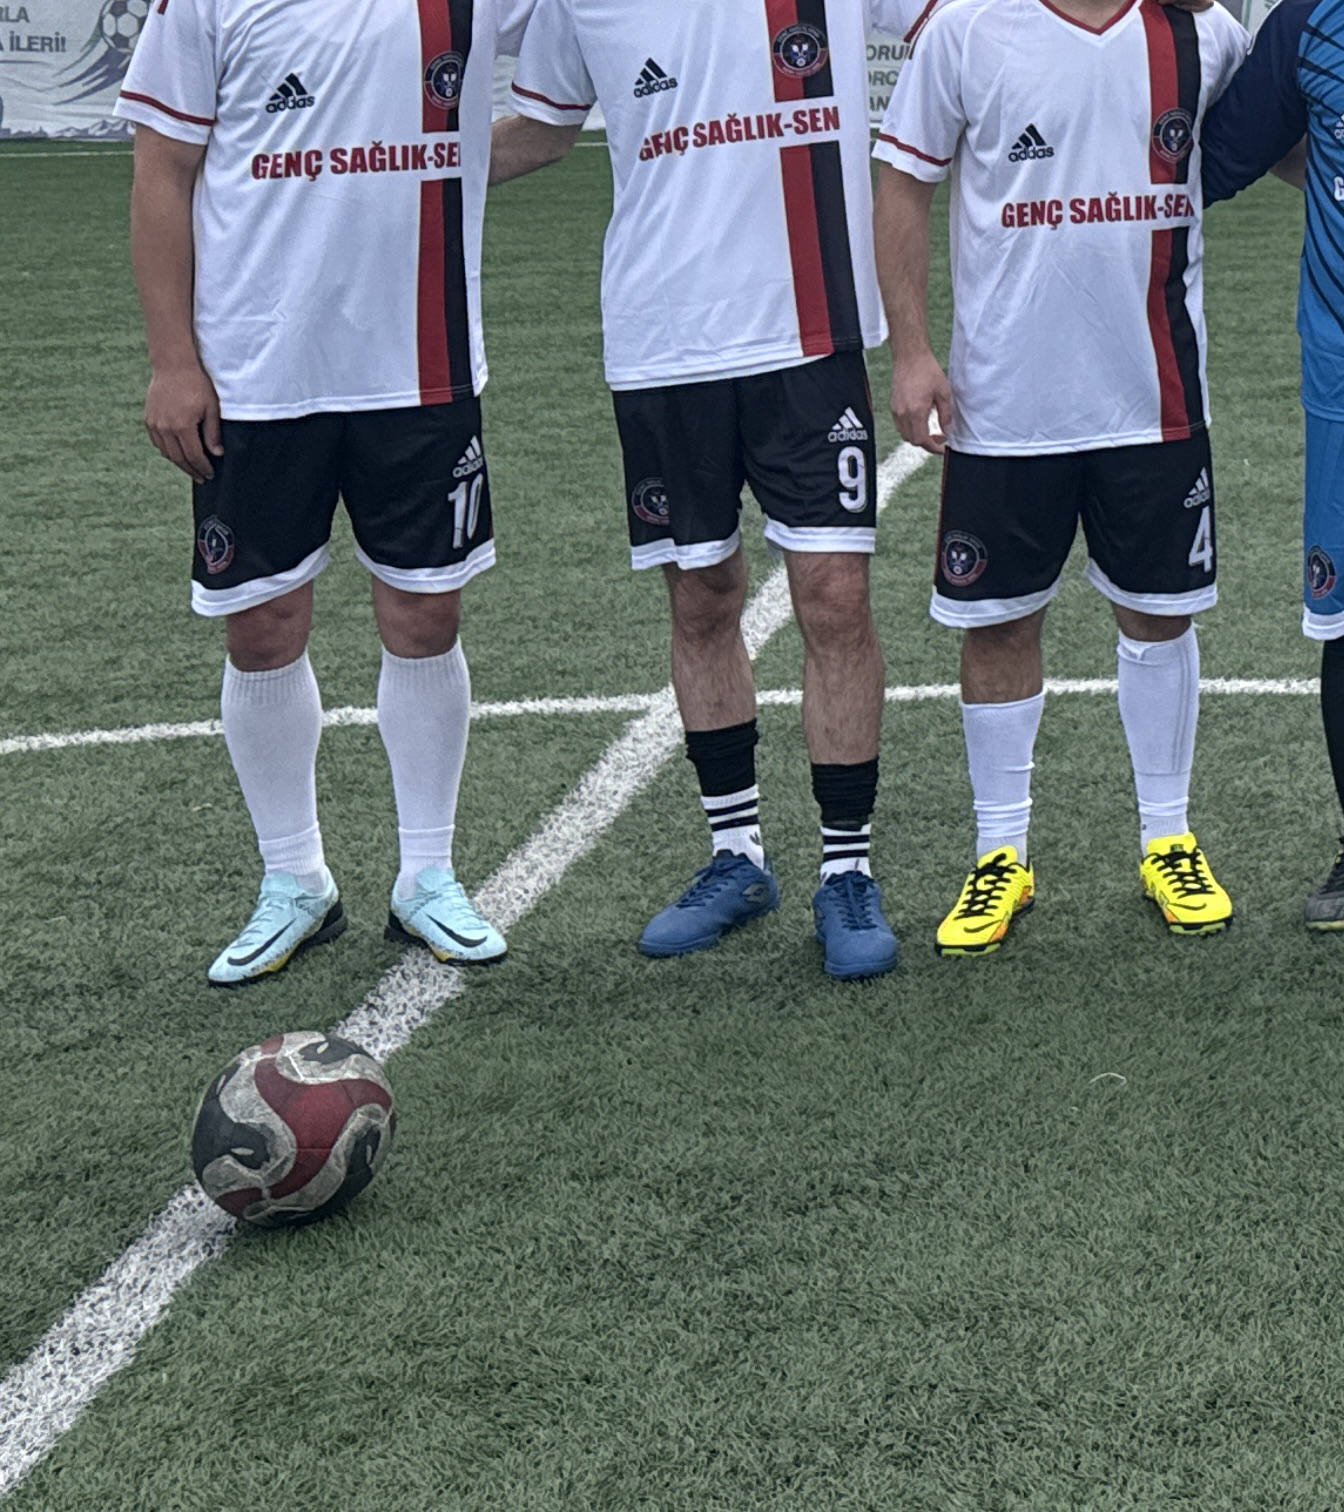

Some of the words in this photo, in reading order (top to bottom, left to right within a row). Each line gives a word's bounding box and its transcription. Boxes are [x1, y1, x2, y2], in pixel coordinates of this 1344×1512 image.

[9, 31, 67, 53] İLERİ!
[693, 105, 841, 149] SAĞLIK-SEN
[251, 149, 323, 182] GENÇ
[329, 140, 461, 175] SAĞLIK-SE
[1001, 199, 1064, 231] GENÇ
[827, 428, 869, 443] adidas
[837, 445, 868, 514] 9
[447, 472, 485, 550] 10
[1187, 505, 1213, 573] 4
